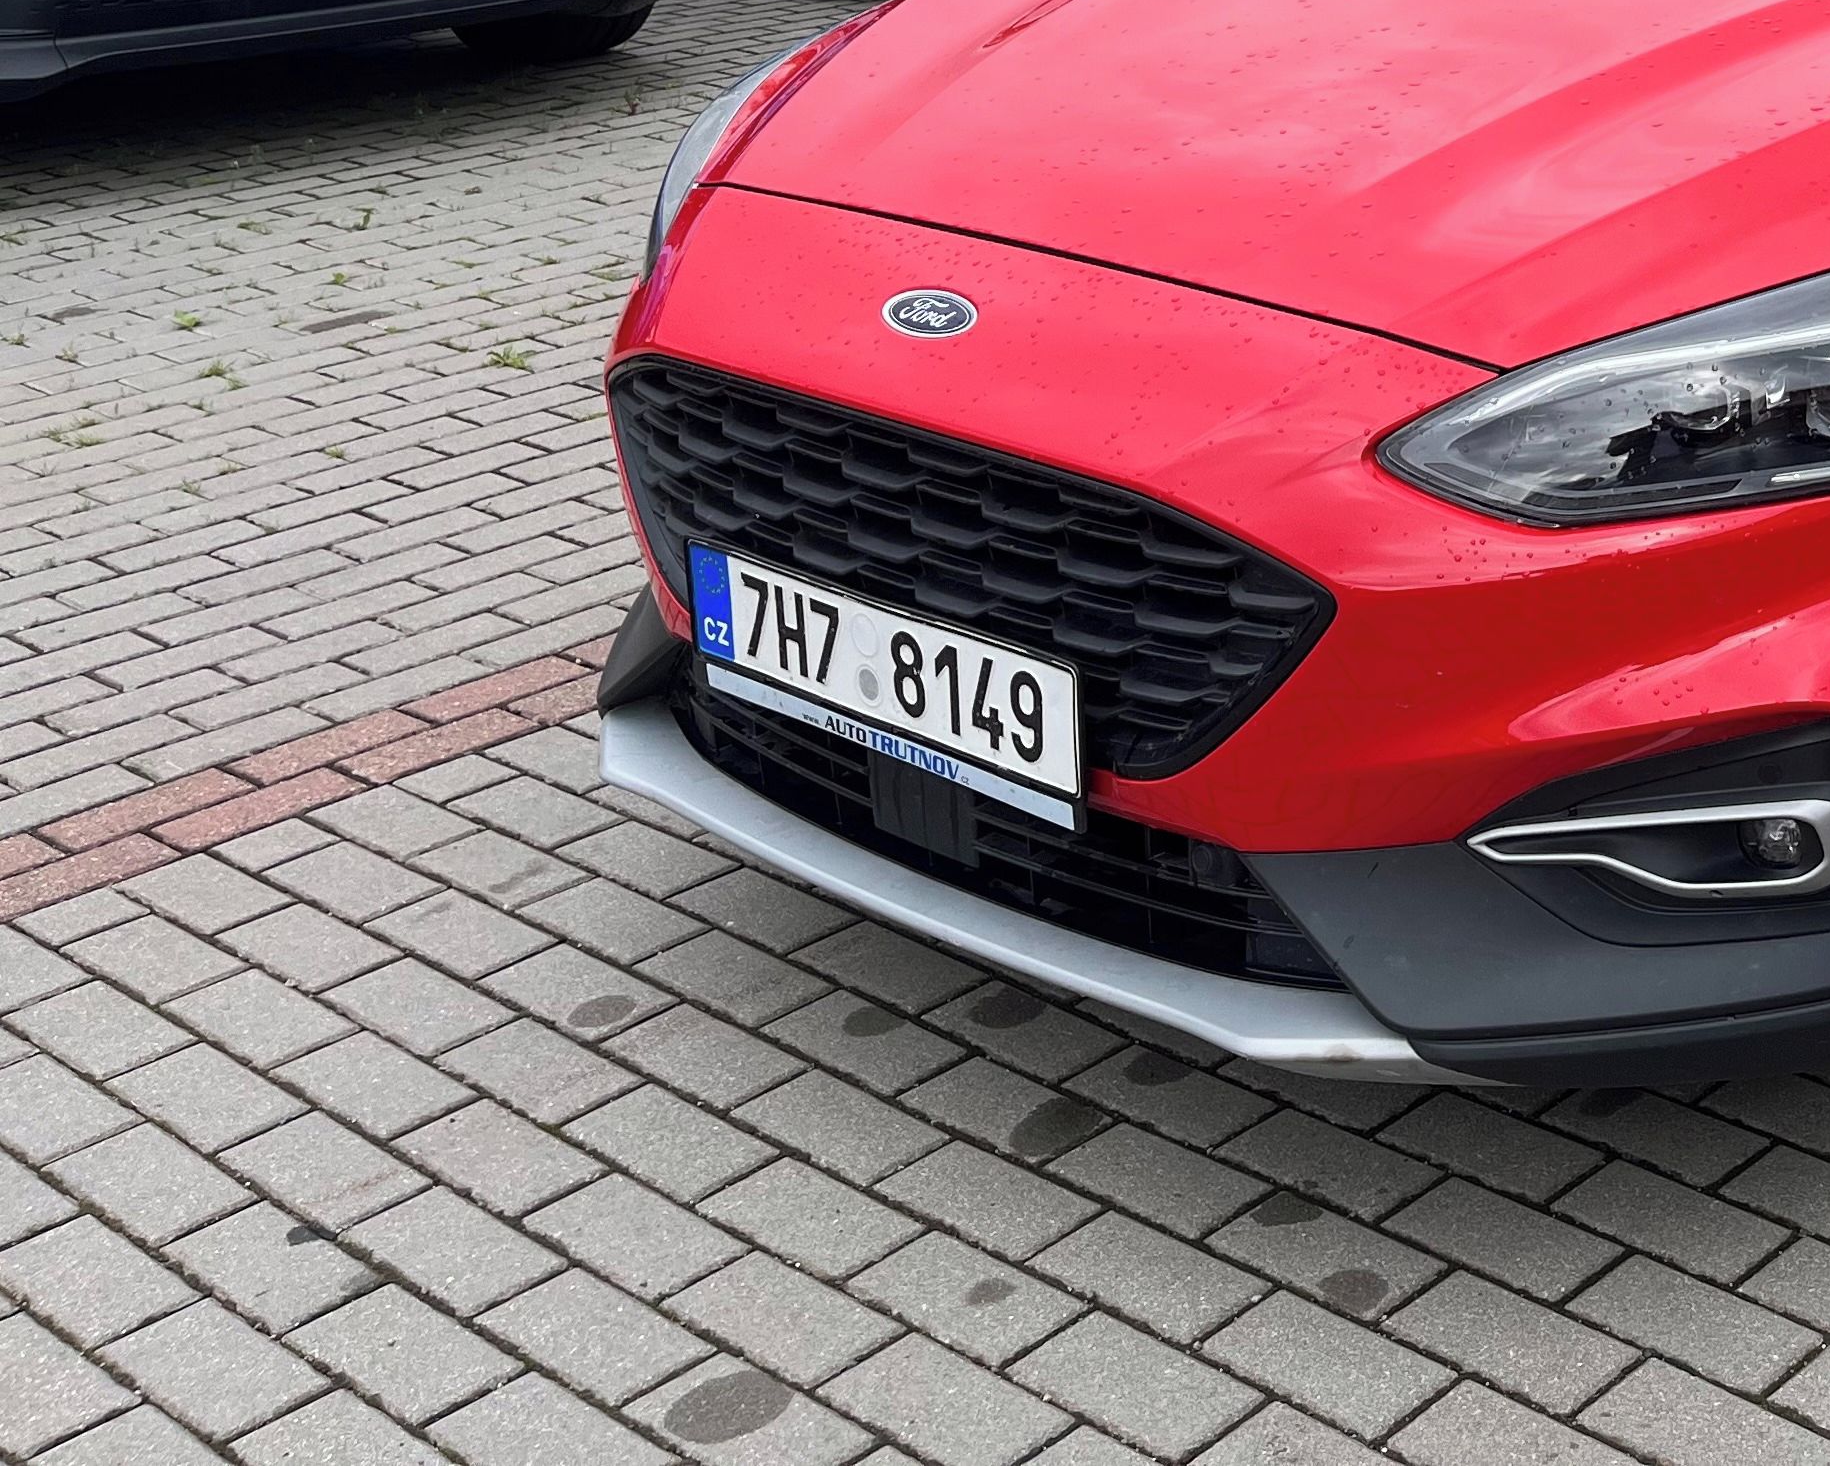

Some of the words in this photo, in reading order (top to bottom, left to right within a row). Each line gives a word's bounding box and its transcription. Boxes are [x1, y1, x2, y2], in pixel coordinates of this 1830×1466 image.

[898, 297, 958, 328] Ford
[703, 615, 730, 647] CZ
[740, 571, 840, 685] 7H7
[889, 629, 1044, 764] 8149
